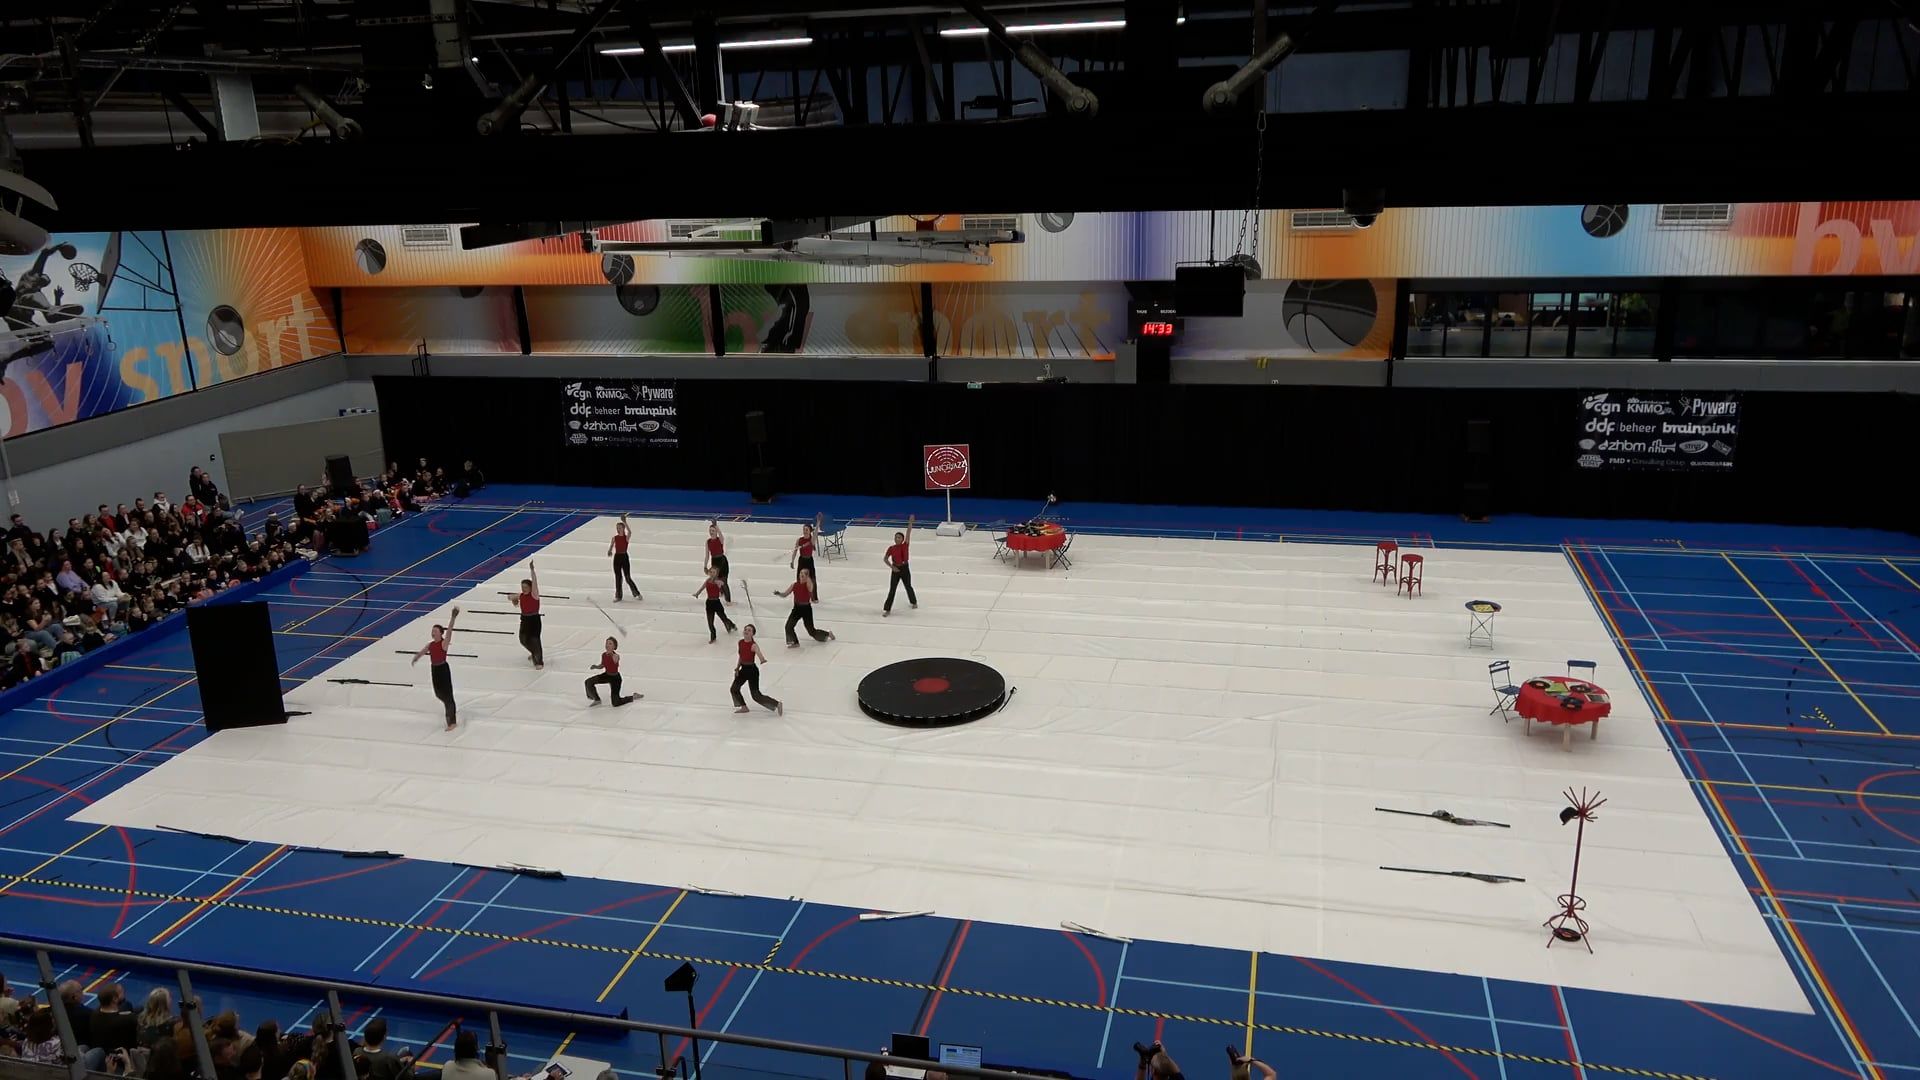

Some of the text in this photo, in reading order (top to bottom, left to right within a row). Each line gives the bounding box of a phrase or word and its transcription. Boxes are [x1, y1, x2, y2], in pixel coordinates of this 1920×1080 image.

[573, 390, 593, 400] cgn
[596, 390, 622, 399] KNMO
[642, 386, 674, 400] Pyware
[570, 402, 621, 418] ddf beheer
[624, 405, 678, 417] brainpink
[1594, 403, 1621, 416] cgn
[1627, 403, 1663, 414] KNMO
[1692, 398, 1737, 416] Pyware
[1585, 418, 1656, 436] ddf beheer
[1662, 422, 1736, 436] brainpink
